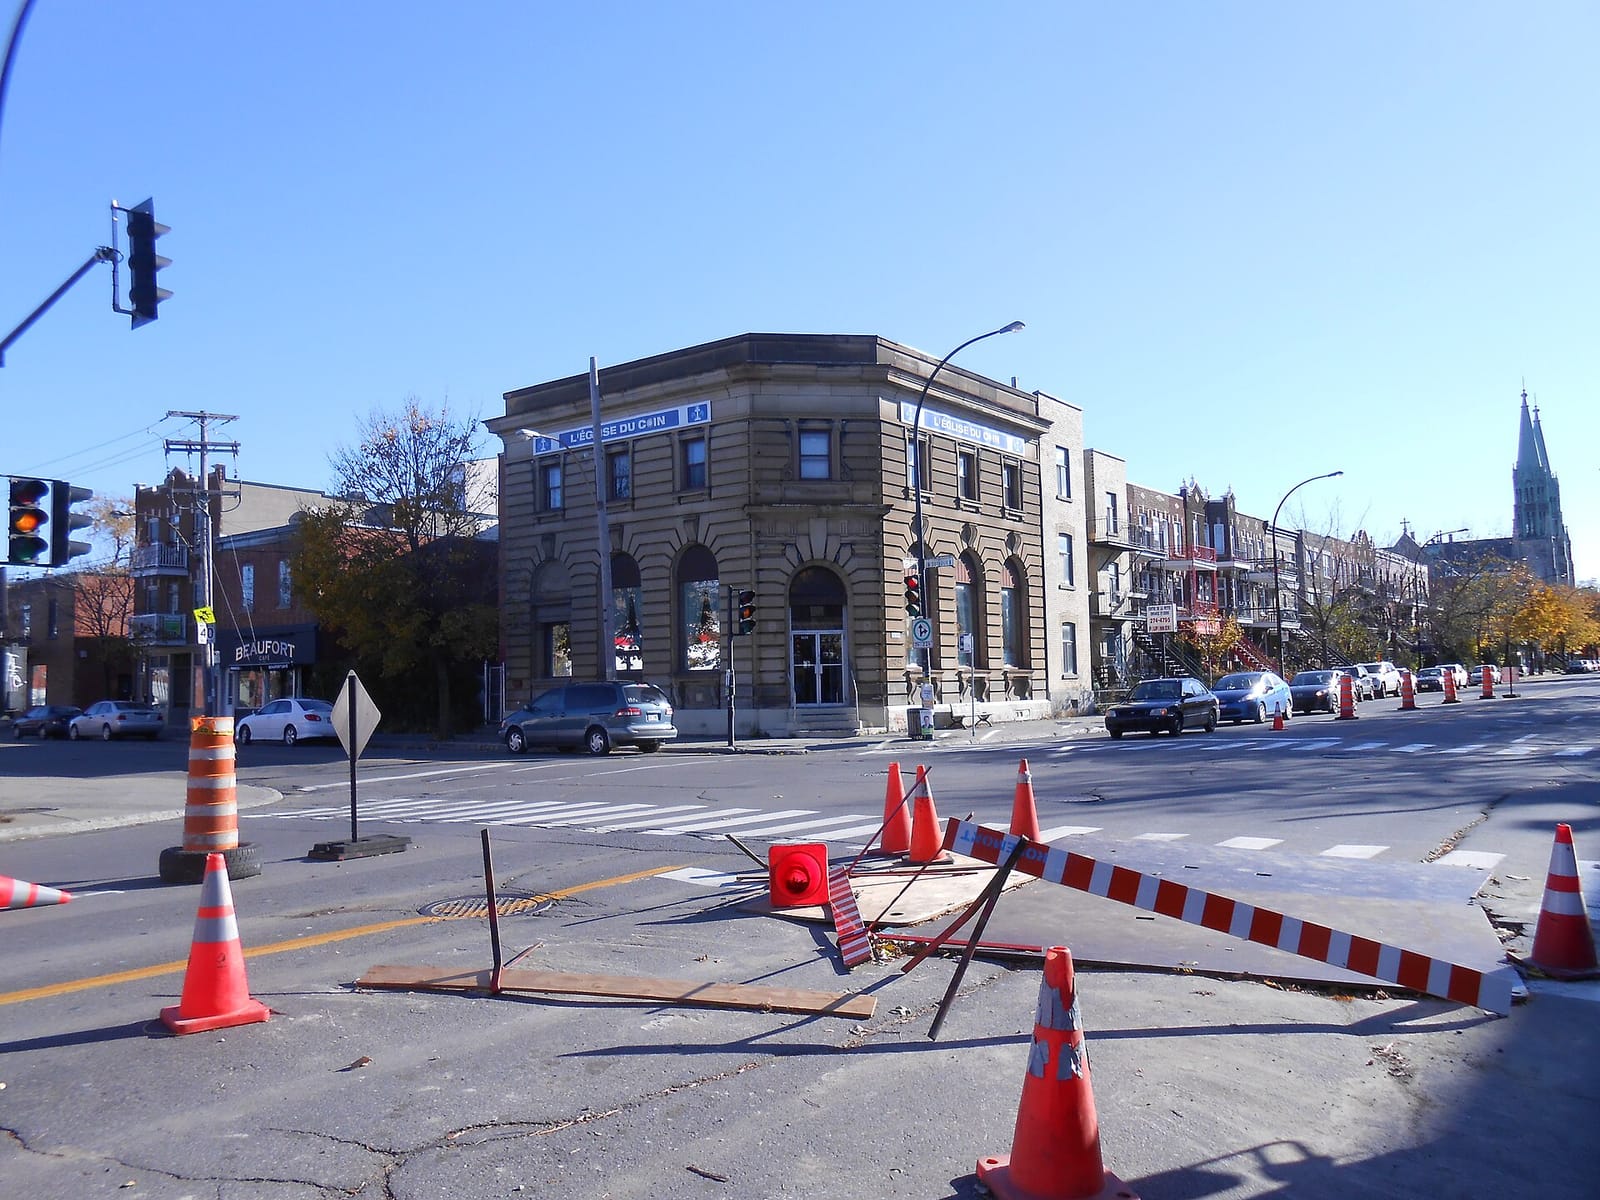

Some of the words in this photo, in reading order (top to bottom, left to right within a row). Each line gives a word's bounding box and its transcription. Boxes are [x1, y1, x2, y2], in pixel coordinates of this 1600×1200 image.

[570, 425, 617, 443] L'ÉGSE
[620, 419, 636, 433] DU
[199, 626, 214, 639] 40
[235, 640, 295, 661] BEAUFORT
[960, 830, 1049, 863] ROEMONT
